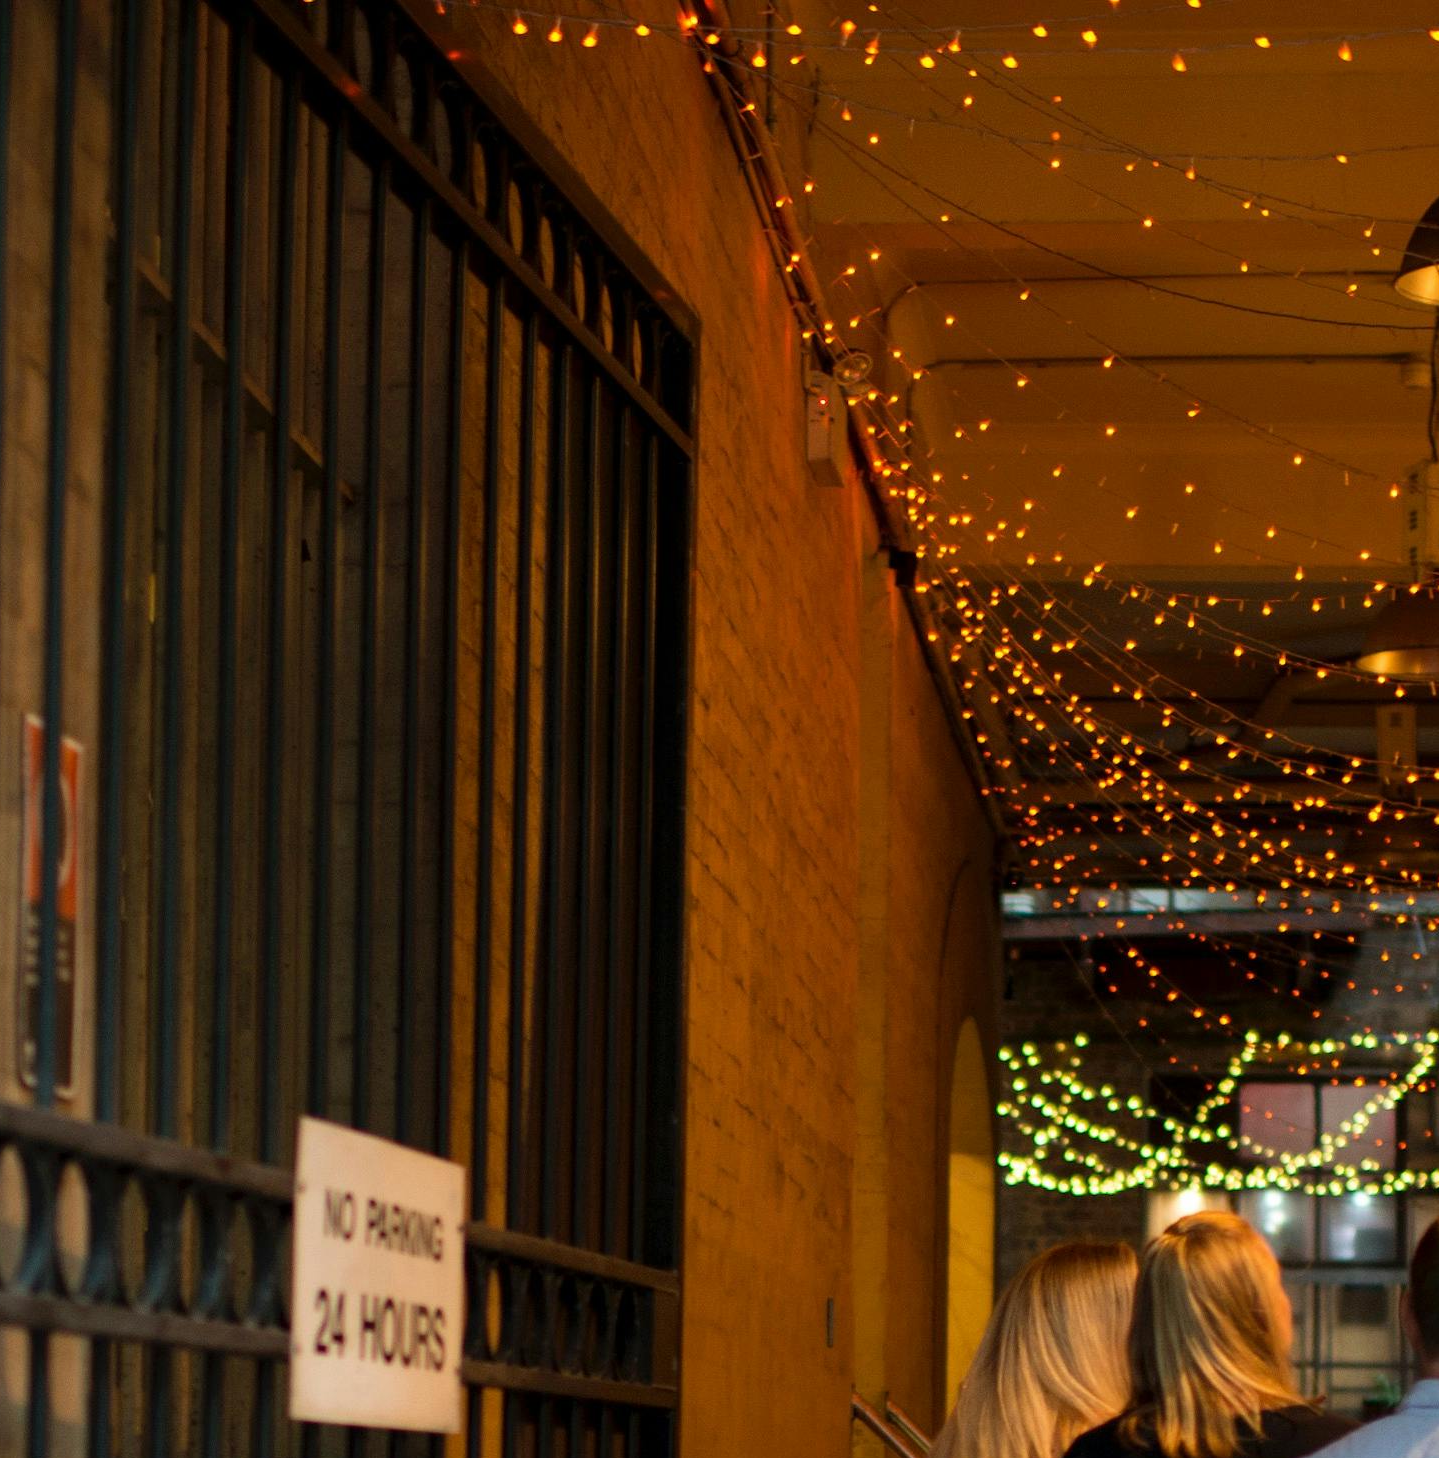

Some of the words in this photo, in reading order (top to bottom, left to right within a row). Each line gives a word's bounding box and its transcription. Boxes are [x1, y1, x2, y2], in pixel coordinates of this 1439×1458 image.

[322, 1188, 355, 1242] NO
[365, 1198, 443, 1262] PARKING
[313, 1288, 346, 1356] 24
[359, 1293, 445, 1373] HOURS
